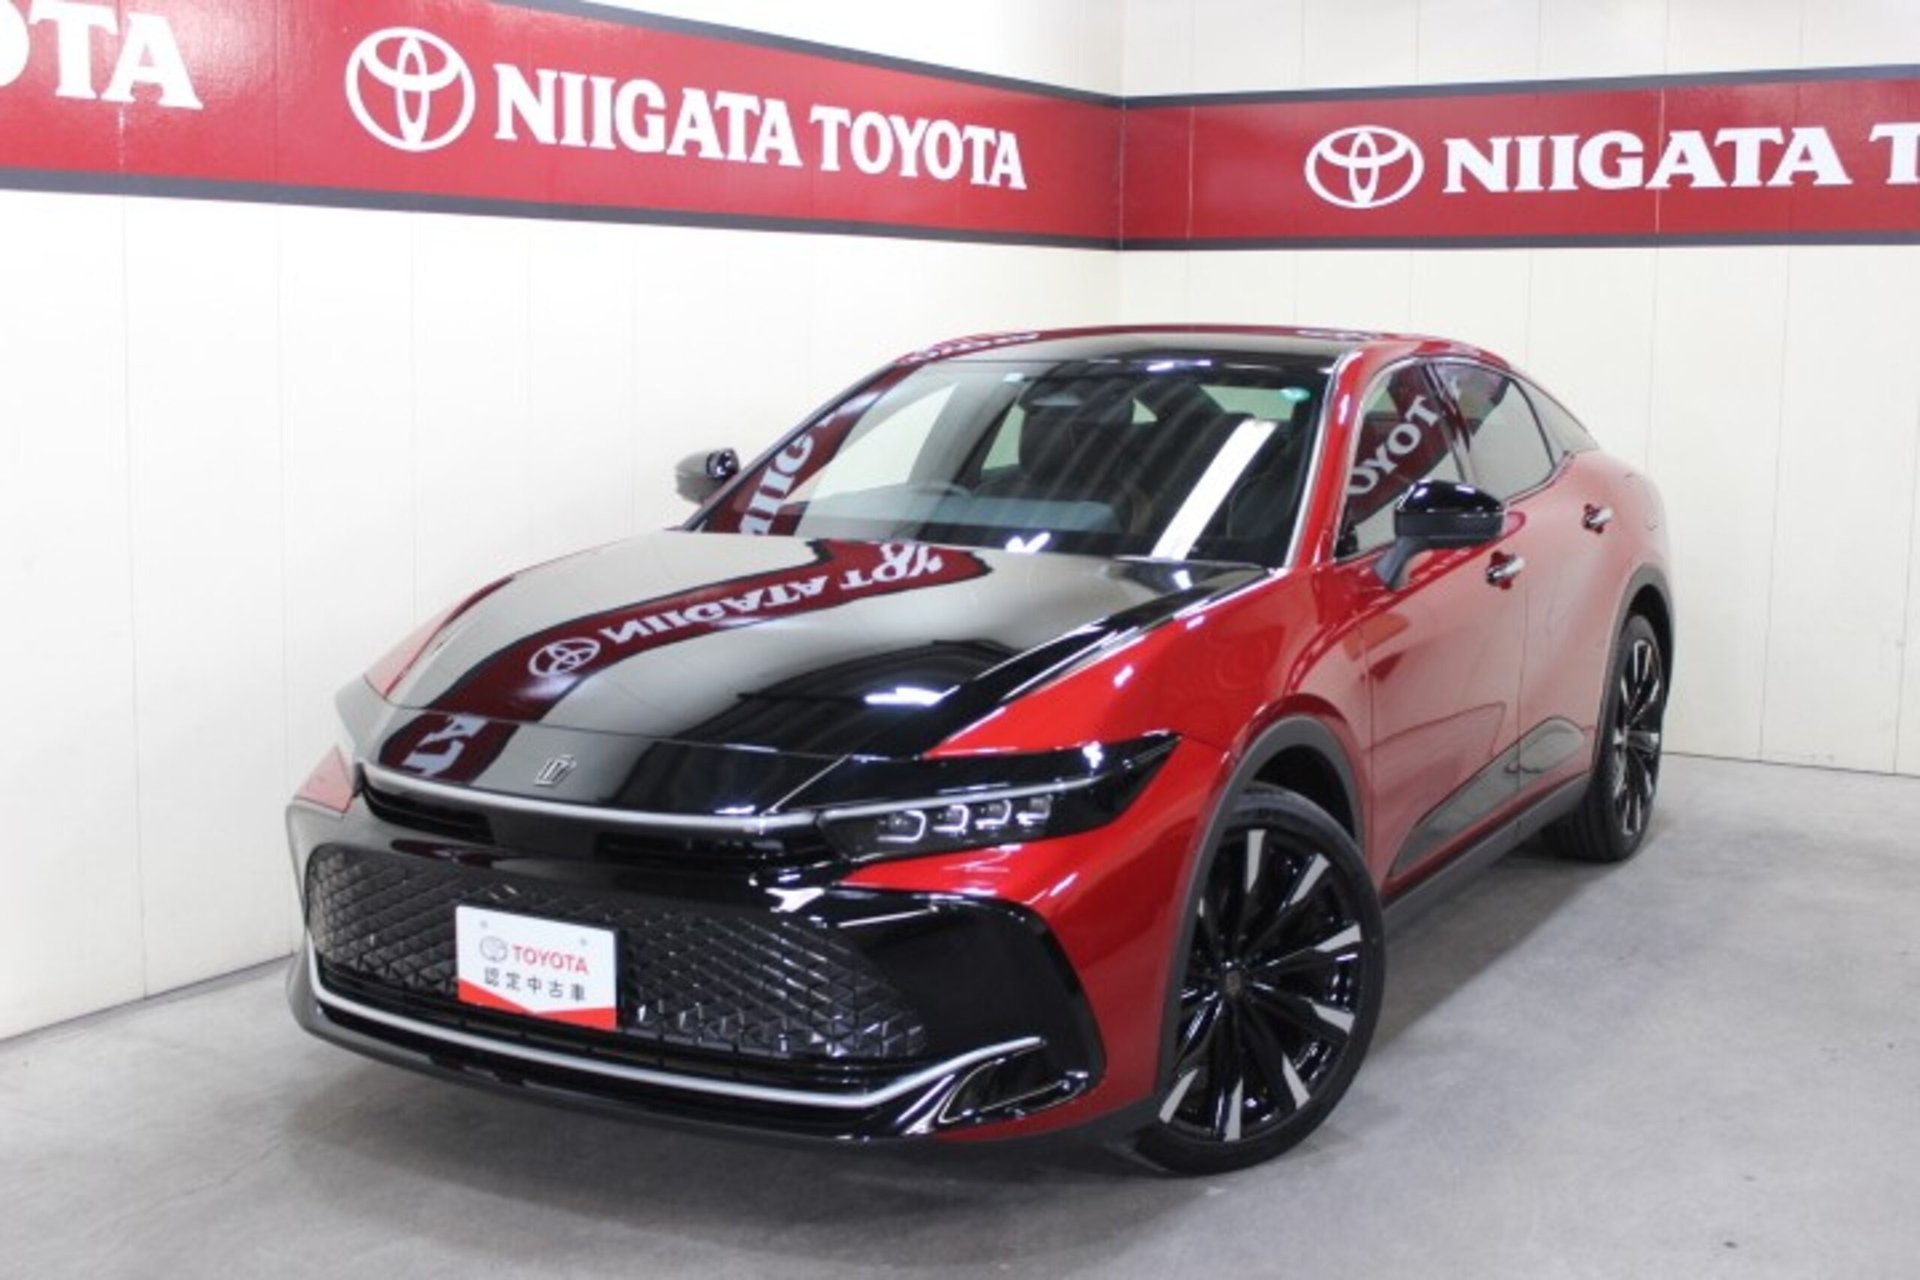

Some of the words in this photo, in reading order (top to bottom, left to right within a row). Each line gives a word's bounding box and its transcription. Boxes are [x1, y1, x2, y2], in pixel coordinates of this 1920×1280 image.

[494, 63, 803, 167] NIIGATA
[811, 105, 1027, 190] TOYOTA
[1443, 126, 1852, 194] NIIGATA
[484, 966, 586, 1002] 認定中古車
[511, 943, 589, 974] TOYOTA
